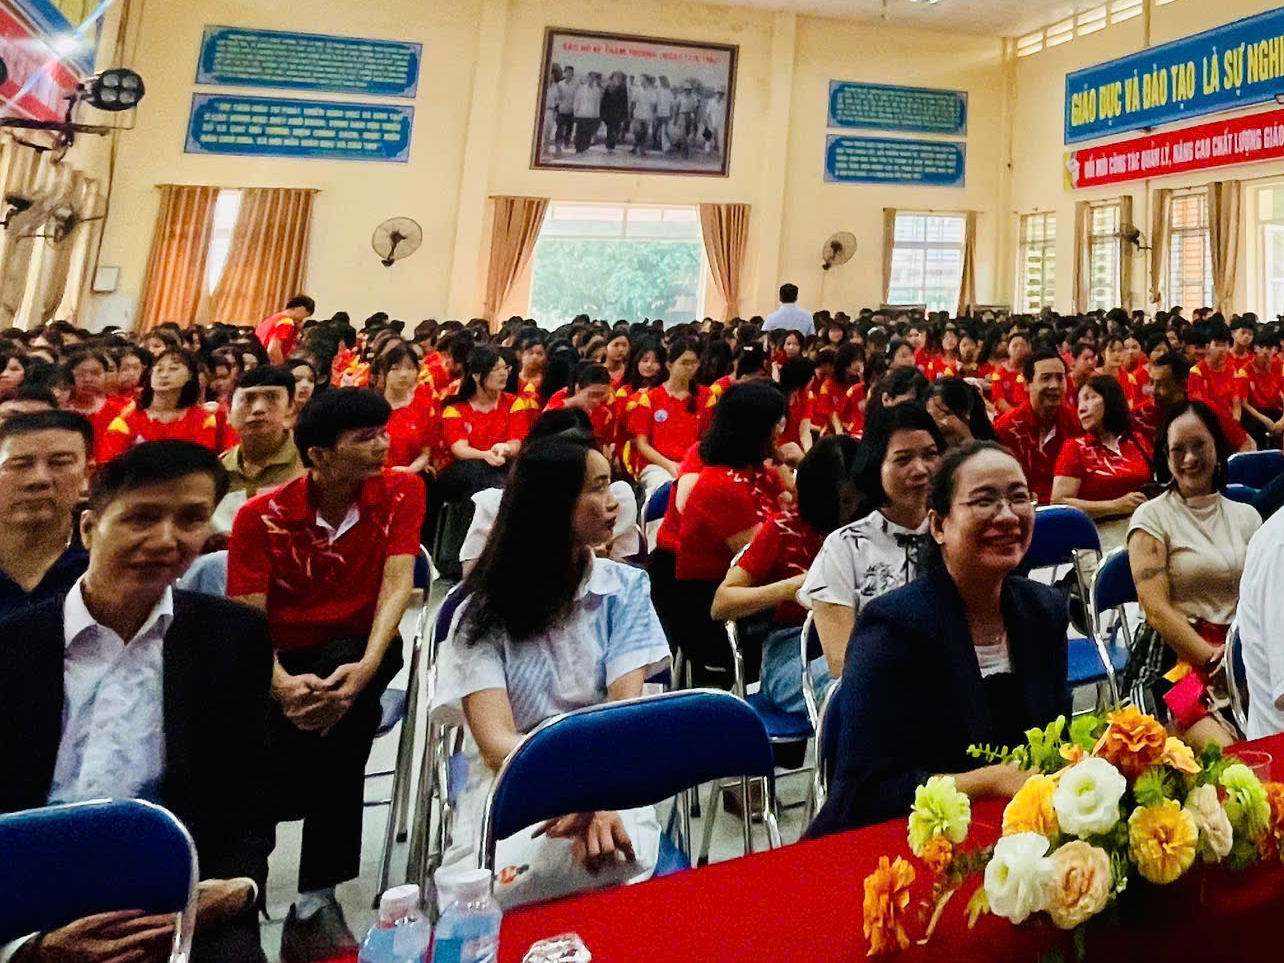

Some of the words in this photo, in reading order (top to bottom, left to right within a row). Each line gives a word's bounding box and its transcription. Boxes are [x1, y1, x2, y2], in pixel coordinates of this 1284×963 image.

[1071, 83, 1096, 126] GIÁO
[1099, 81, 1121, 126] DỤC
[1125, 69, 1139, 113] VÀ
[1143, 64, 1167, 109] ĐÀO
[1171, 61, 1196, 109] TẠO
[1203, 46, 1219, 95] LÀ
[1224, 42, 1245, 96] SỰ
[1212, 127, 1233, 157] CHẤT
[1234, 127, 1262, 156] LƯỢNG
[1264, 121, 1284, 149] GIÁO
